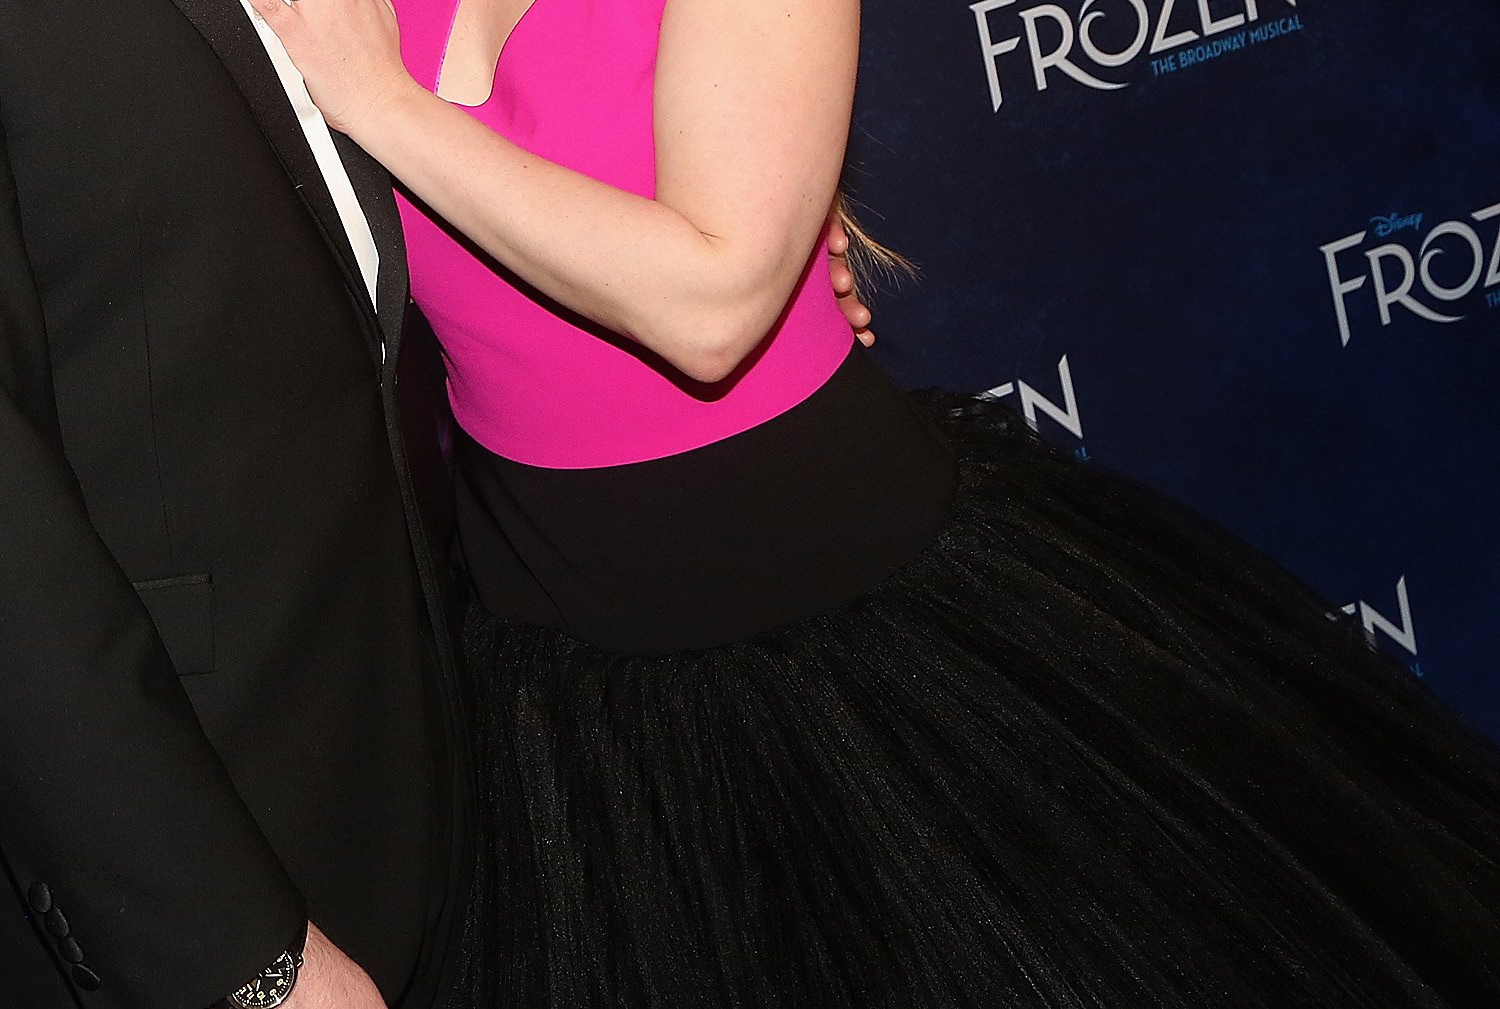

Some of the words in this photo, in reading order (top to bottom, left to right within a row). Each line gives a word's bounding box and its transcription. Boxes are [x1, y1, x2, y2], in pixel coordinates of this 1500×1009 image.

[1151, 57, 1177, 76] THE
[1180, 36, 1246, 69] BROADWAY
[1250, 14, 1304, 44] MUSICAL
